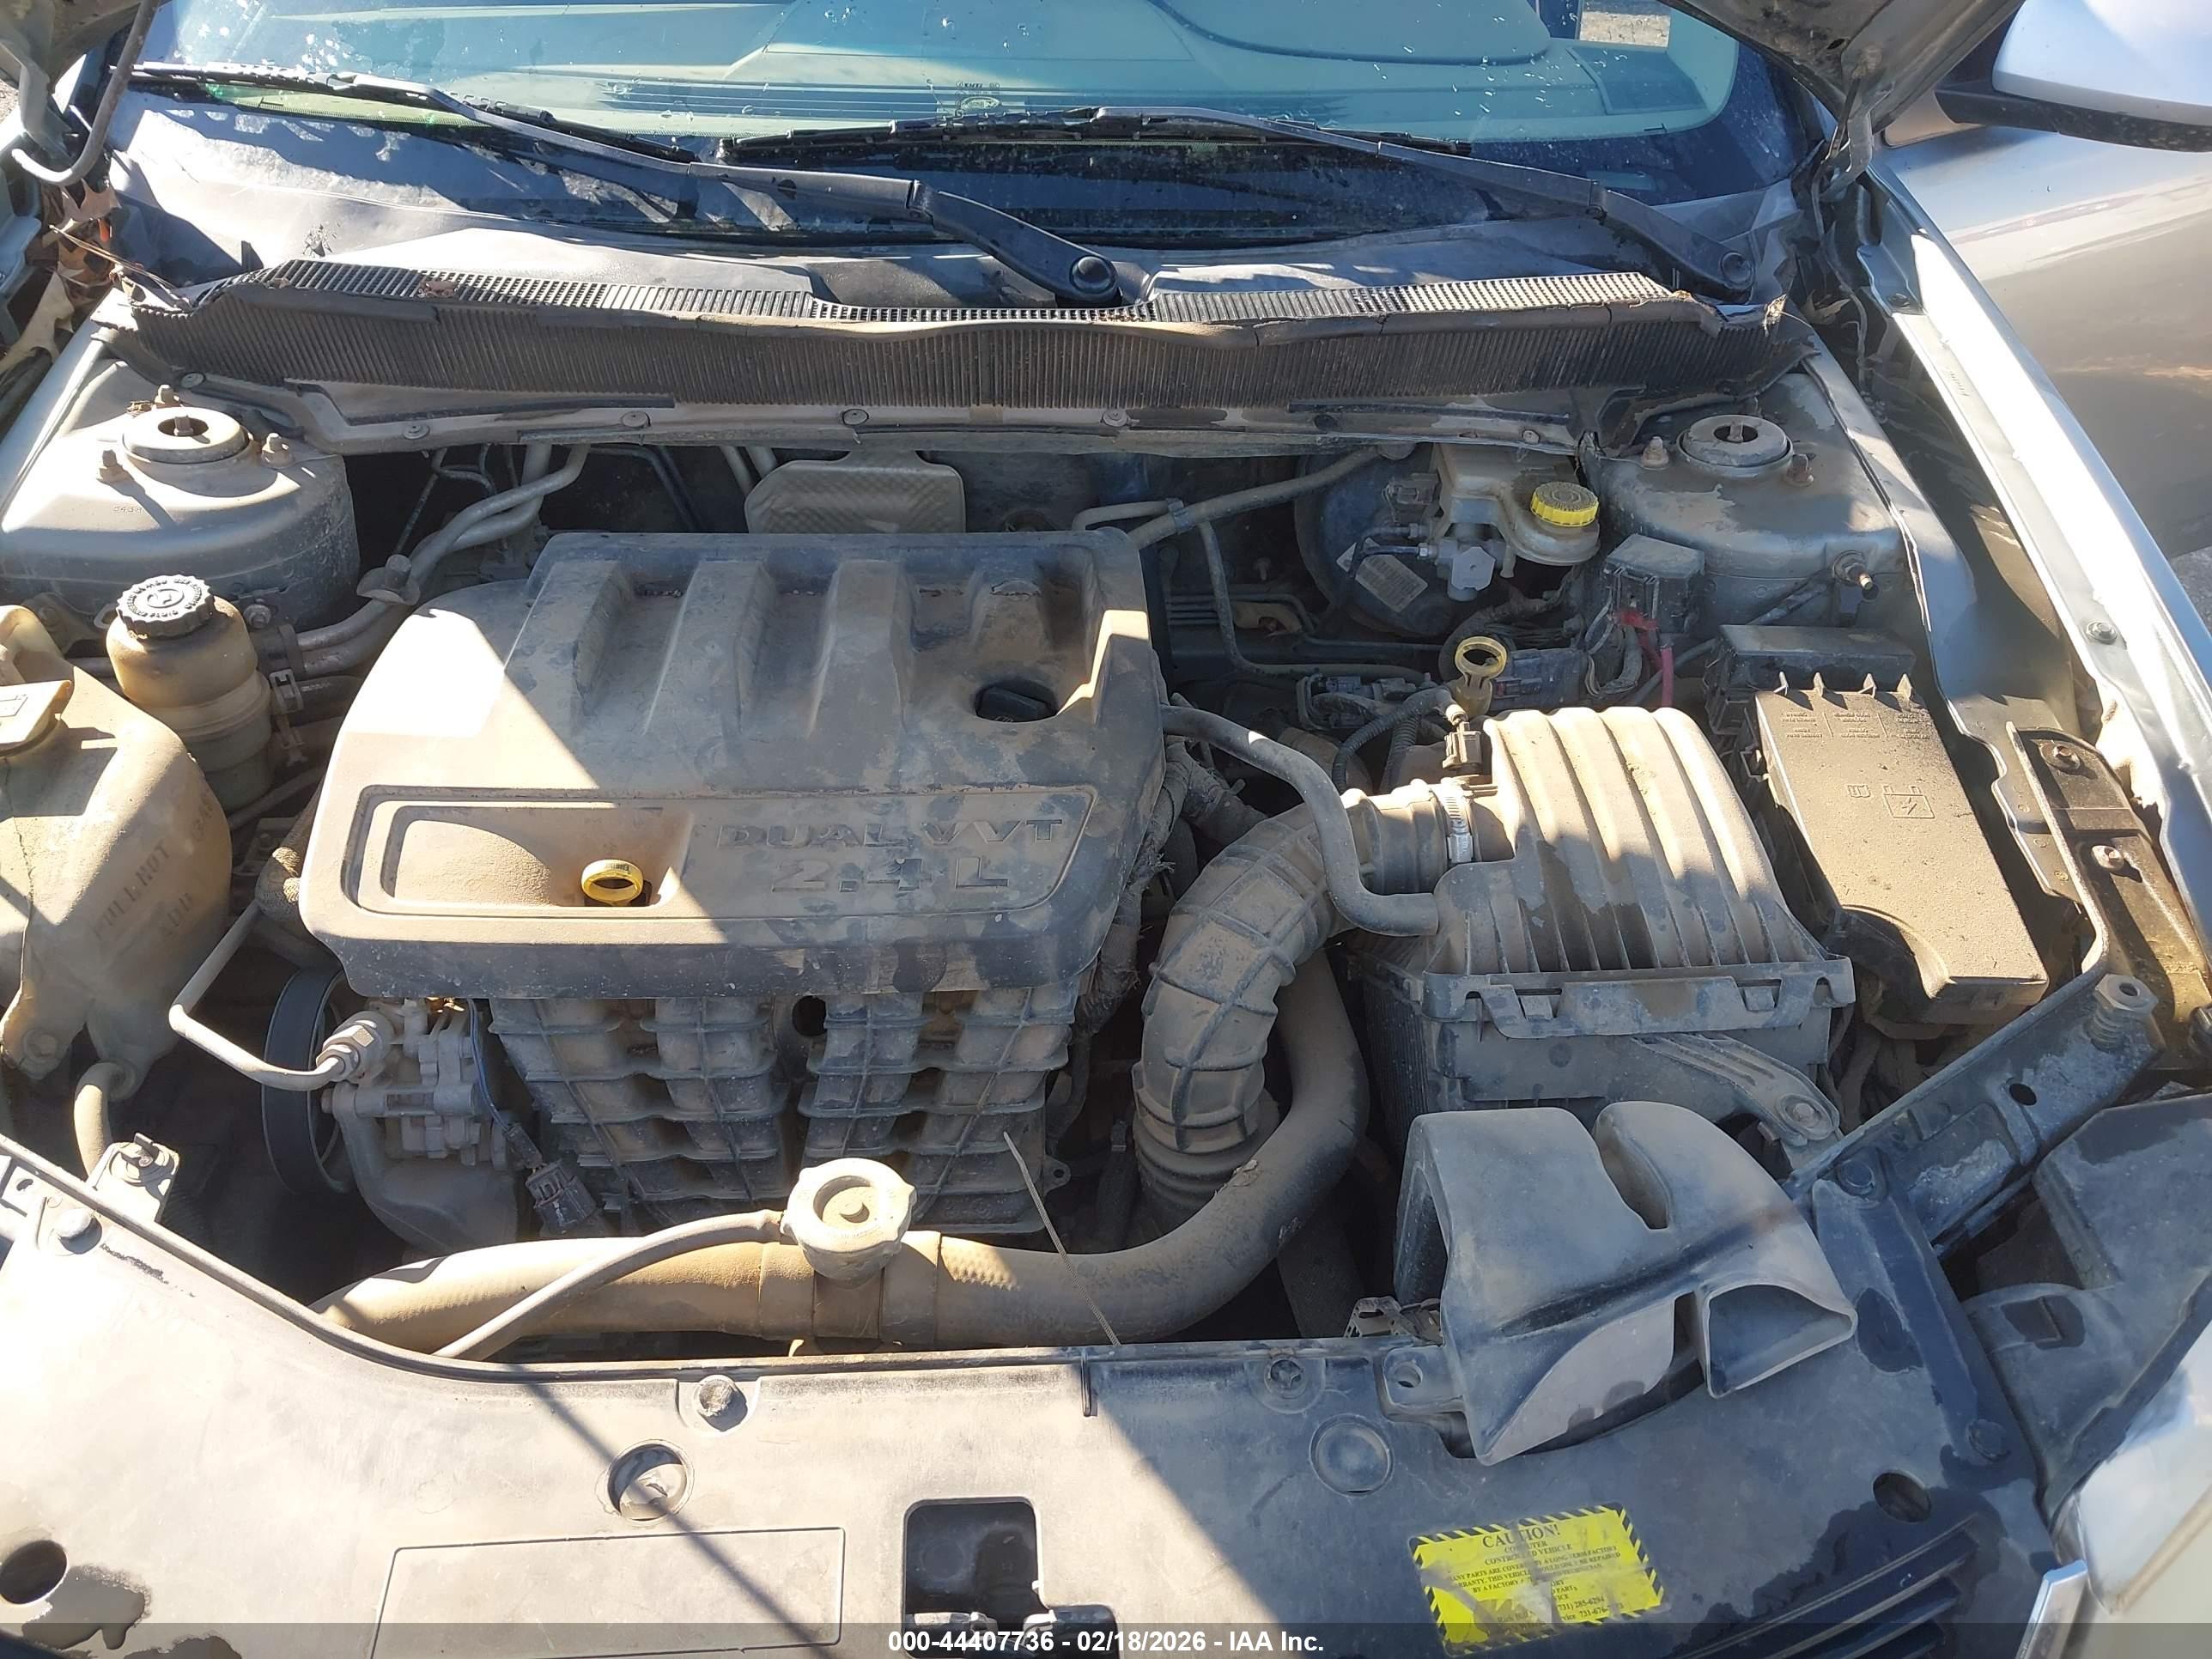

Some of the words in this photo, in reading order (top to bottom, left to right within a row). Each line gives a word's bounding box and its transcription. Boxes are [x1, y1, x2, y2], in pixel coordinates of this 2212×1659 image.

[716, 823, 908, 848] DUAL
[920, 818, 1063, 846] VVT
[1482, 1523, 1560, 1549] CAUTION!
[1504, 1540, 1547, 1553] COUTER
[1485, 1550, 1538, 1565] CONTROD
[1502, 1562, 1528, 1573] COVER
[1458, 1577, 1487, 1588] RRANTY.
